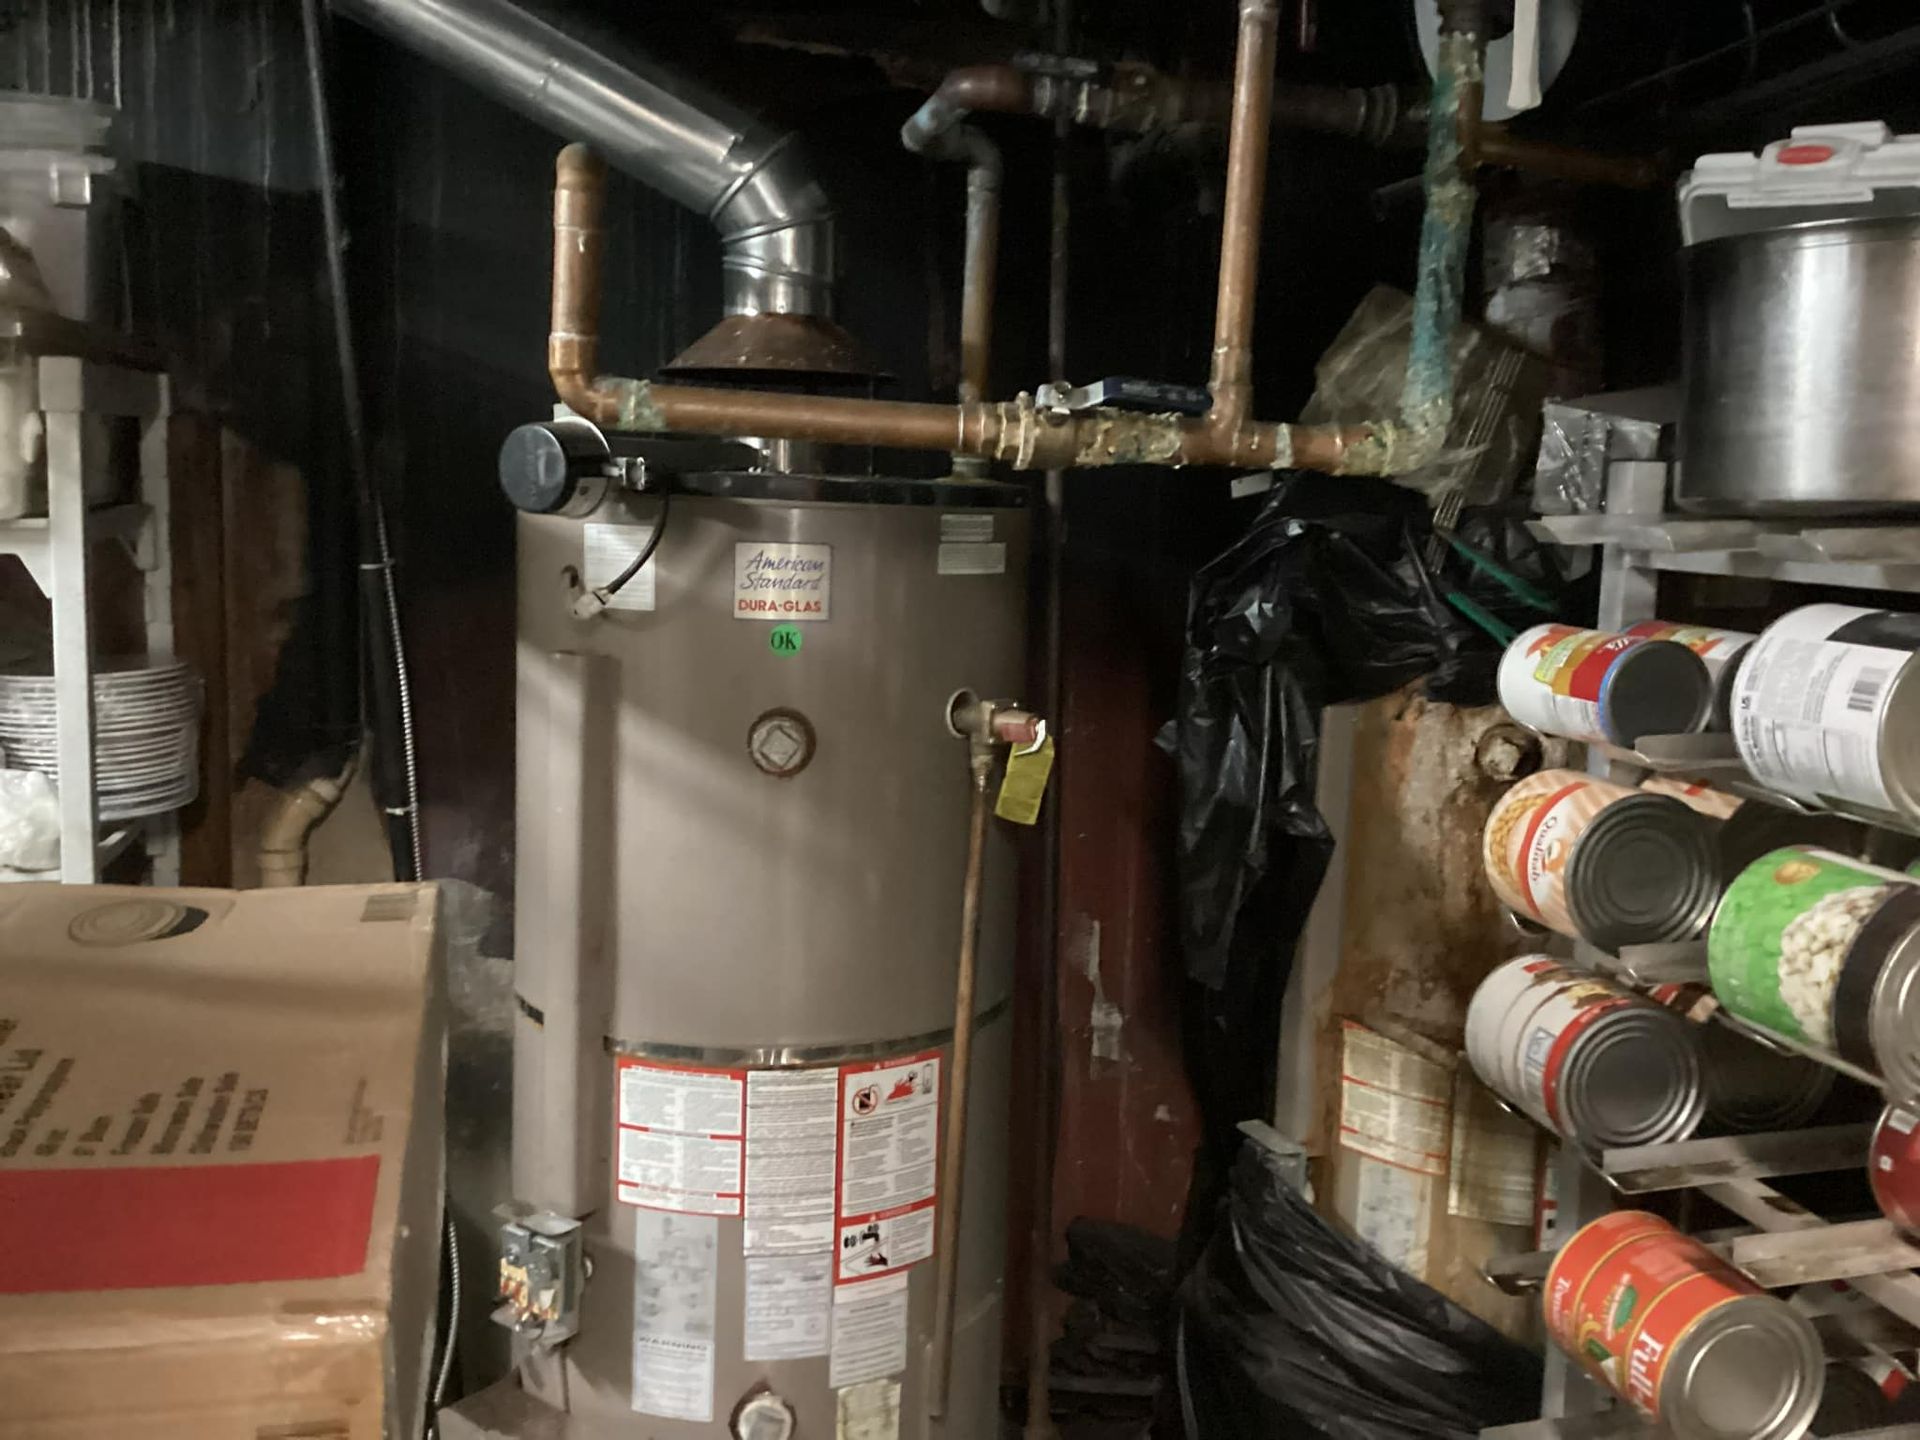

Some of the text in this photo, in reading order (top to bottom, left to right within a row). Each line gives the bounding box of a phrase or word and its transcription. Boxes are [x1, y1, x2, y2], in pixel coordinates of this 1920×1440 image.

[745, 550, 825, 572] American
[741, 571, 825, 591] Standard
[738, 599, 822, 612] DURA-GLAS
[771, 631, 797, 650] OK
